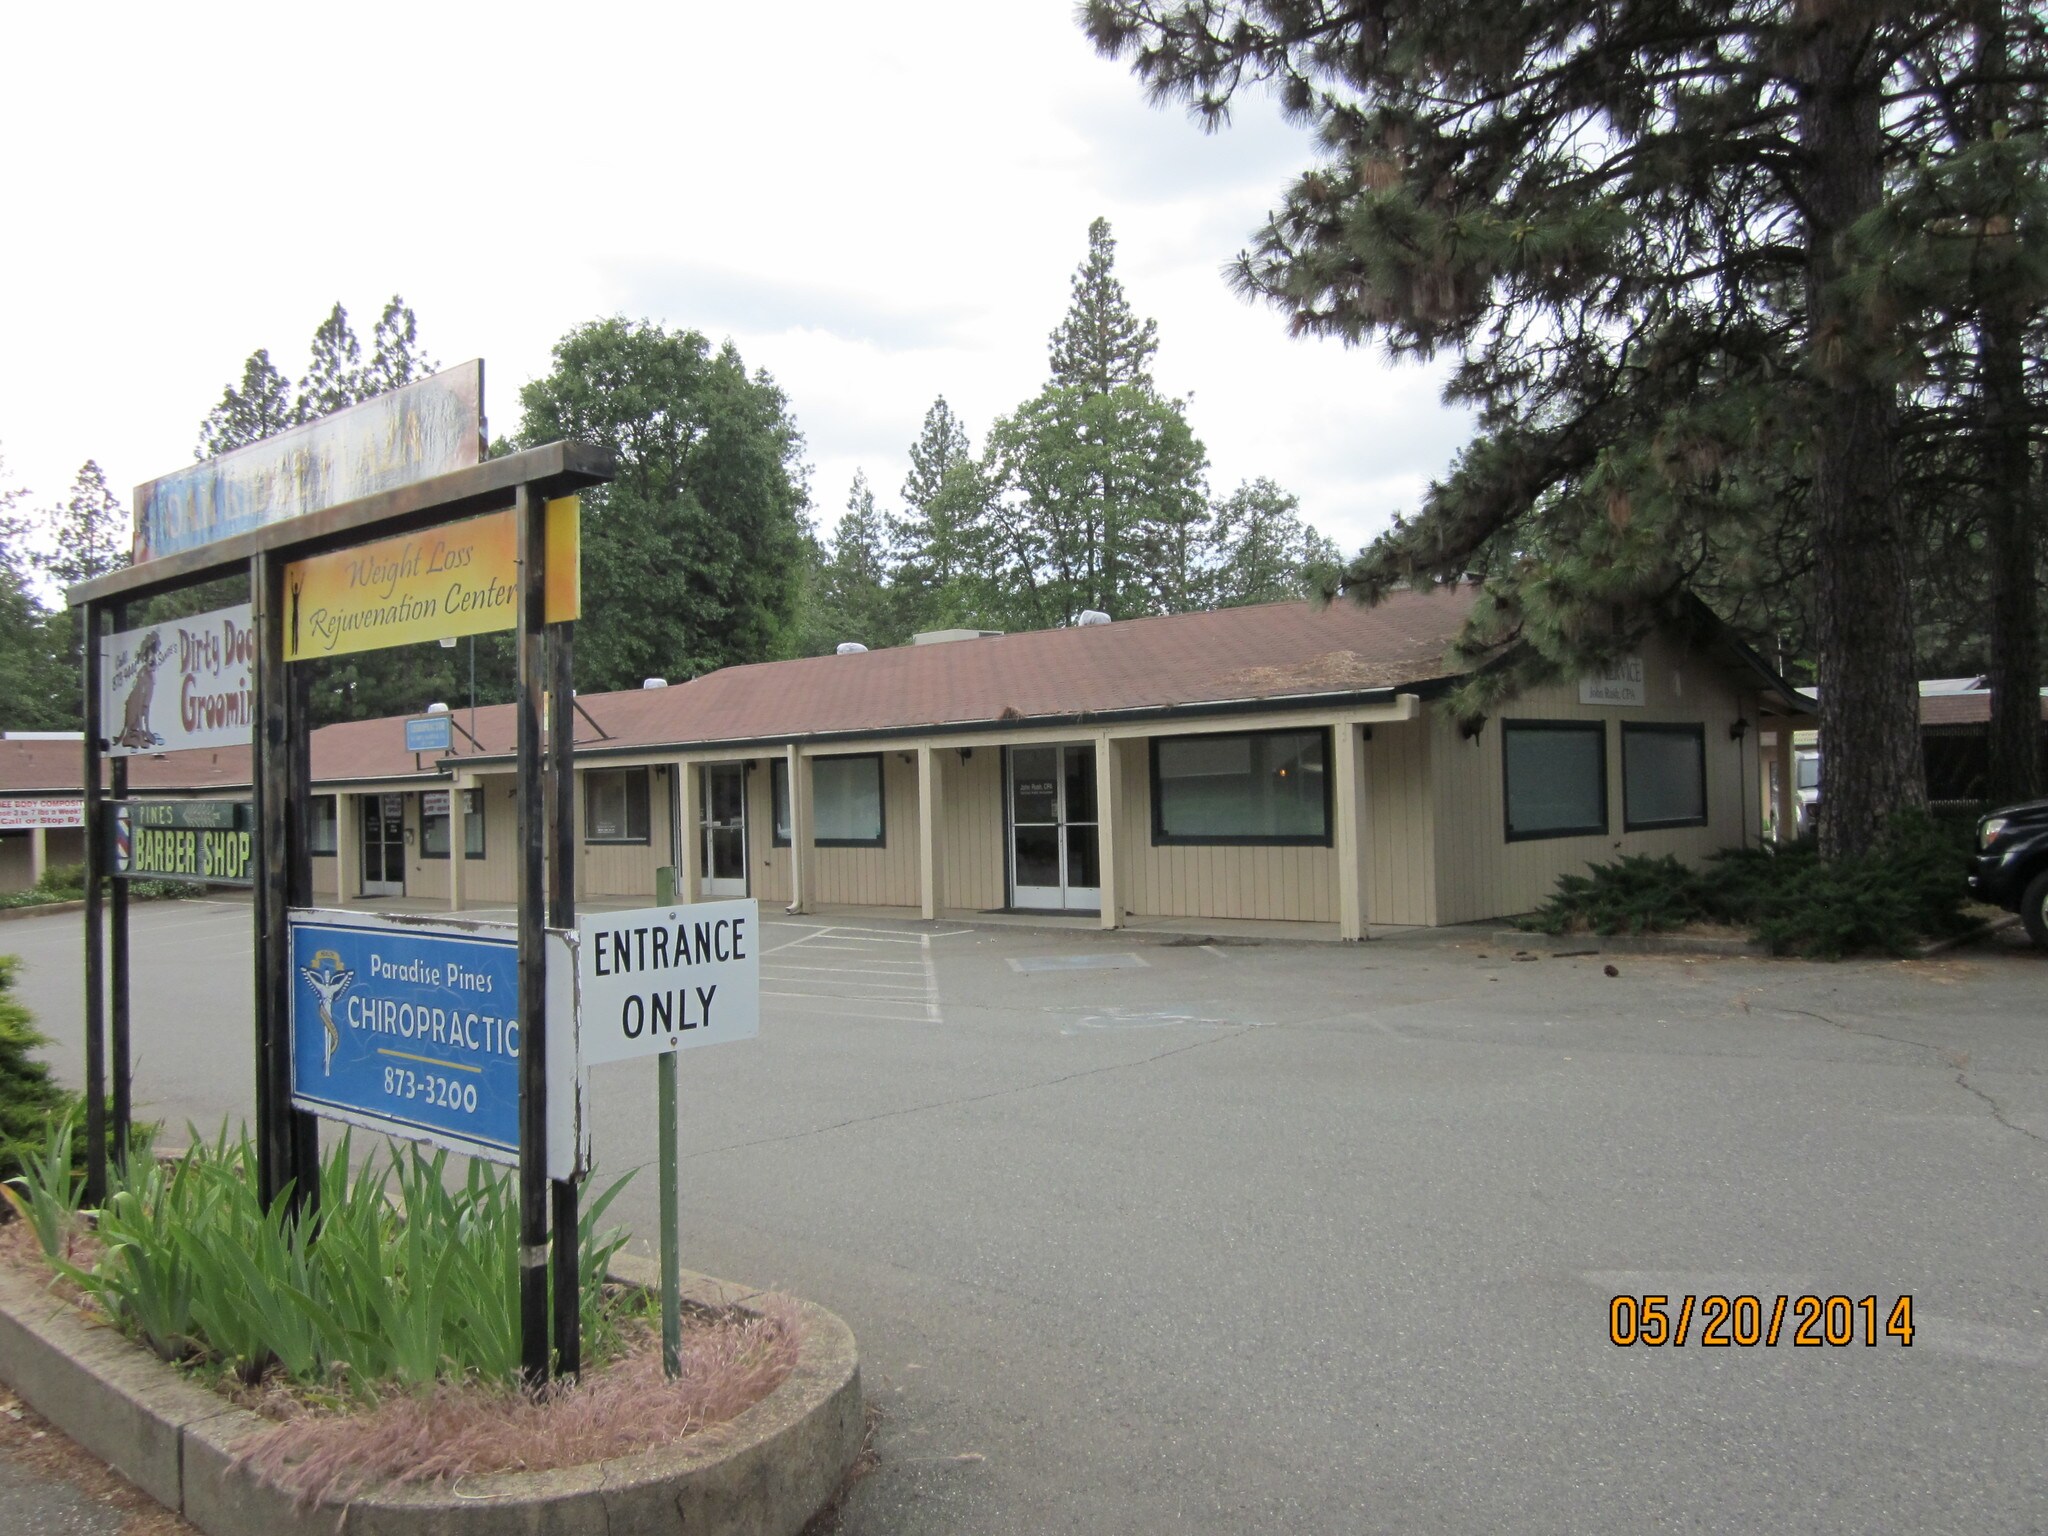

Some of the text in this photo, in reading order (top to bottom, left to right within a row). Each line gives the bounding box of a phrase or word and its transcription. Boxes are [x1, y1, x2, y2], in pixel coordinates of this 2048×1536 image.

[346, 542, 473, 599] Weight Loss
[310, 577, 517, 650] Rejuvenation Center
[178, 628, 219, 676] Dirty
[15, 800, 37, 808] BODY
[67, 816, 80, 824] By
[140, 806, 173, 824] PINES
[136, 828, 250, 877] BARBER SHOP
[594, 918, 746, 977] ENTRANCE
[370, 953, 493, 994] Paradise Pines
[347, 995, 519, 1058] CHIROPRACTIC
[622, 984, 717, 1040] ONLY
[384, 1066, 477, 1114] 873-3200
